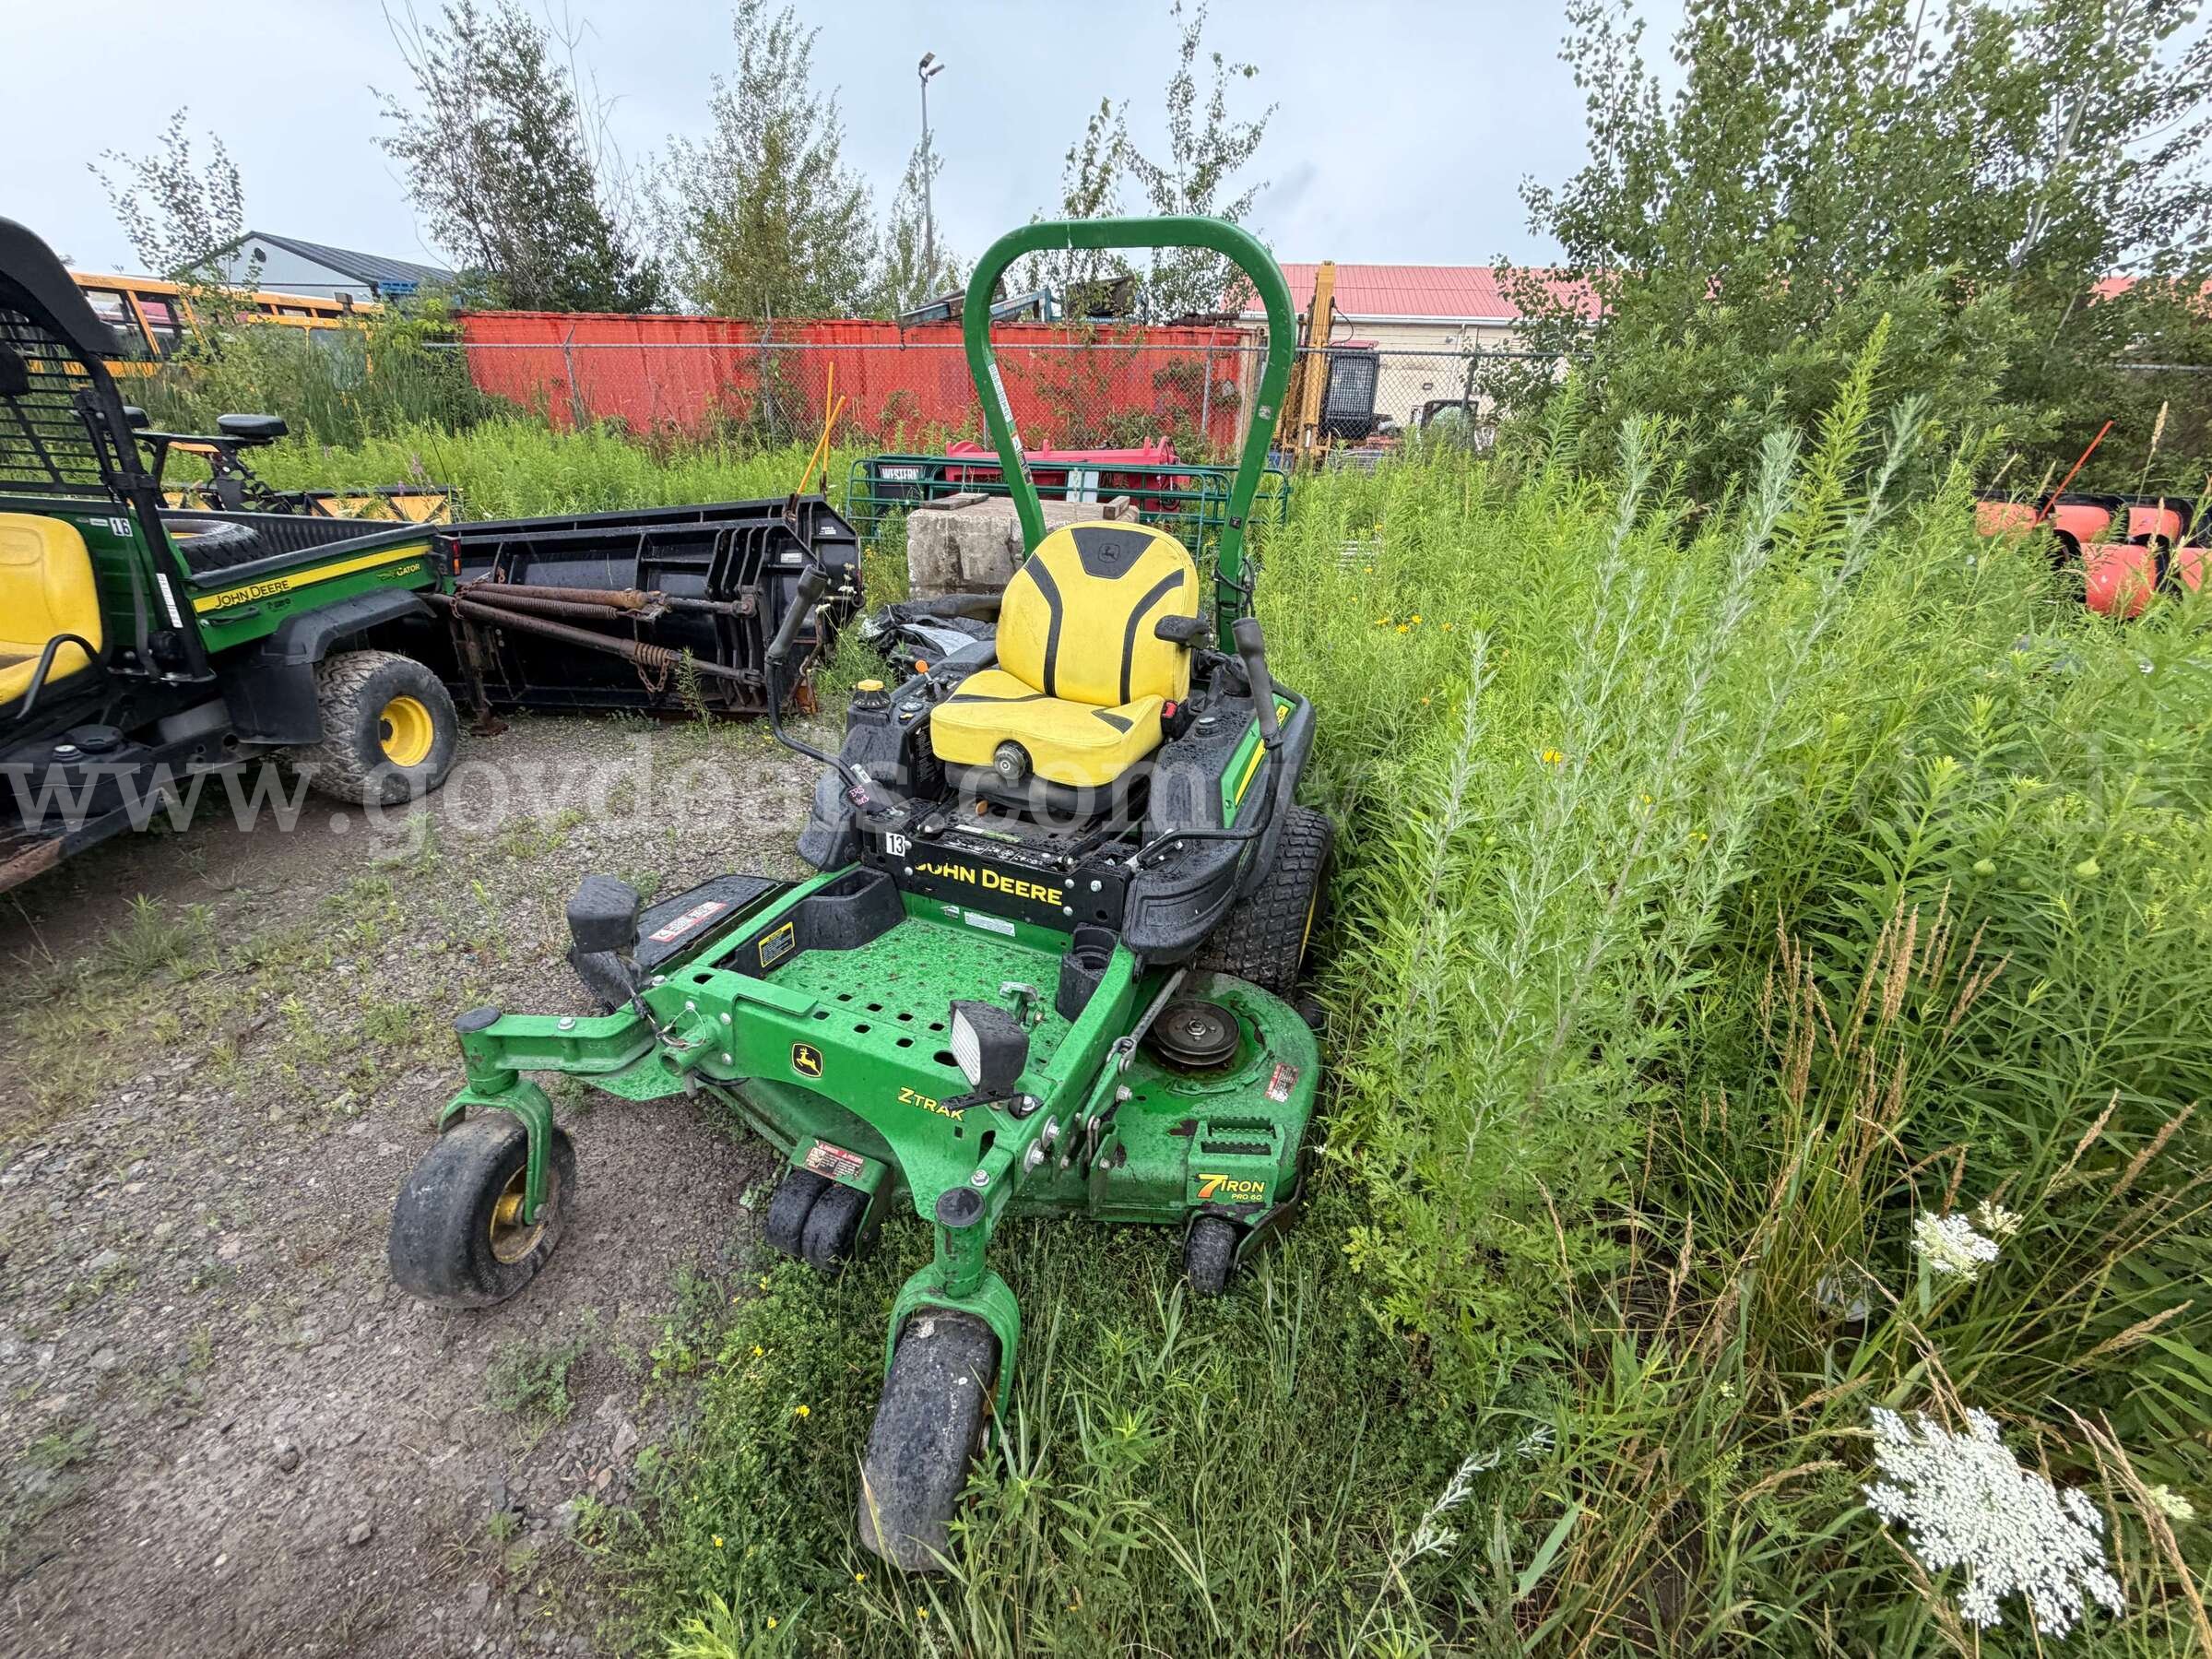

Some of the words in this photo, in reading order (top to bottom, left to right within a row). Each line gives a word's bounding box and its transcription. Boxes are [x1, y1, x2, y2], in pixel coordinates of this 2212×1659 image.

[881, 468, 918, 480] WESTERN
[112, 518, 130, 535] 16
[396, 563, 420, 576] GATOR
[215, 590, 250, 609] JOHN
[250, 579, 290, 599] DEERE
[889, 835, 904, 854] 13
[981, 869, 1063, 907] DEERE
[898, 1086, 966, 1122] ZTRAK
